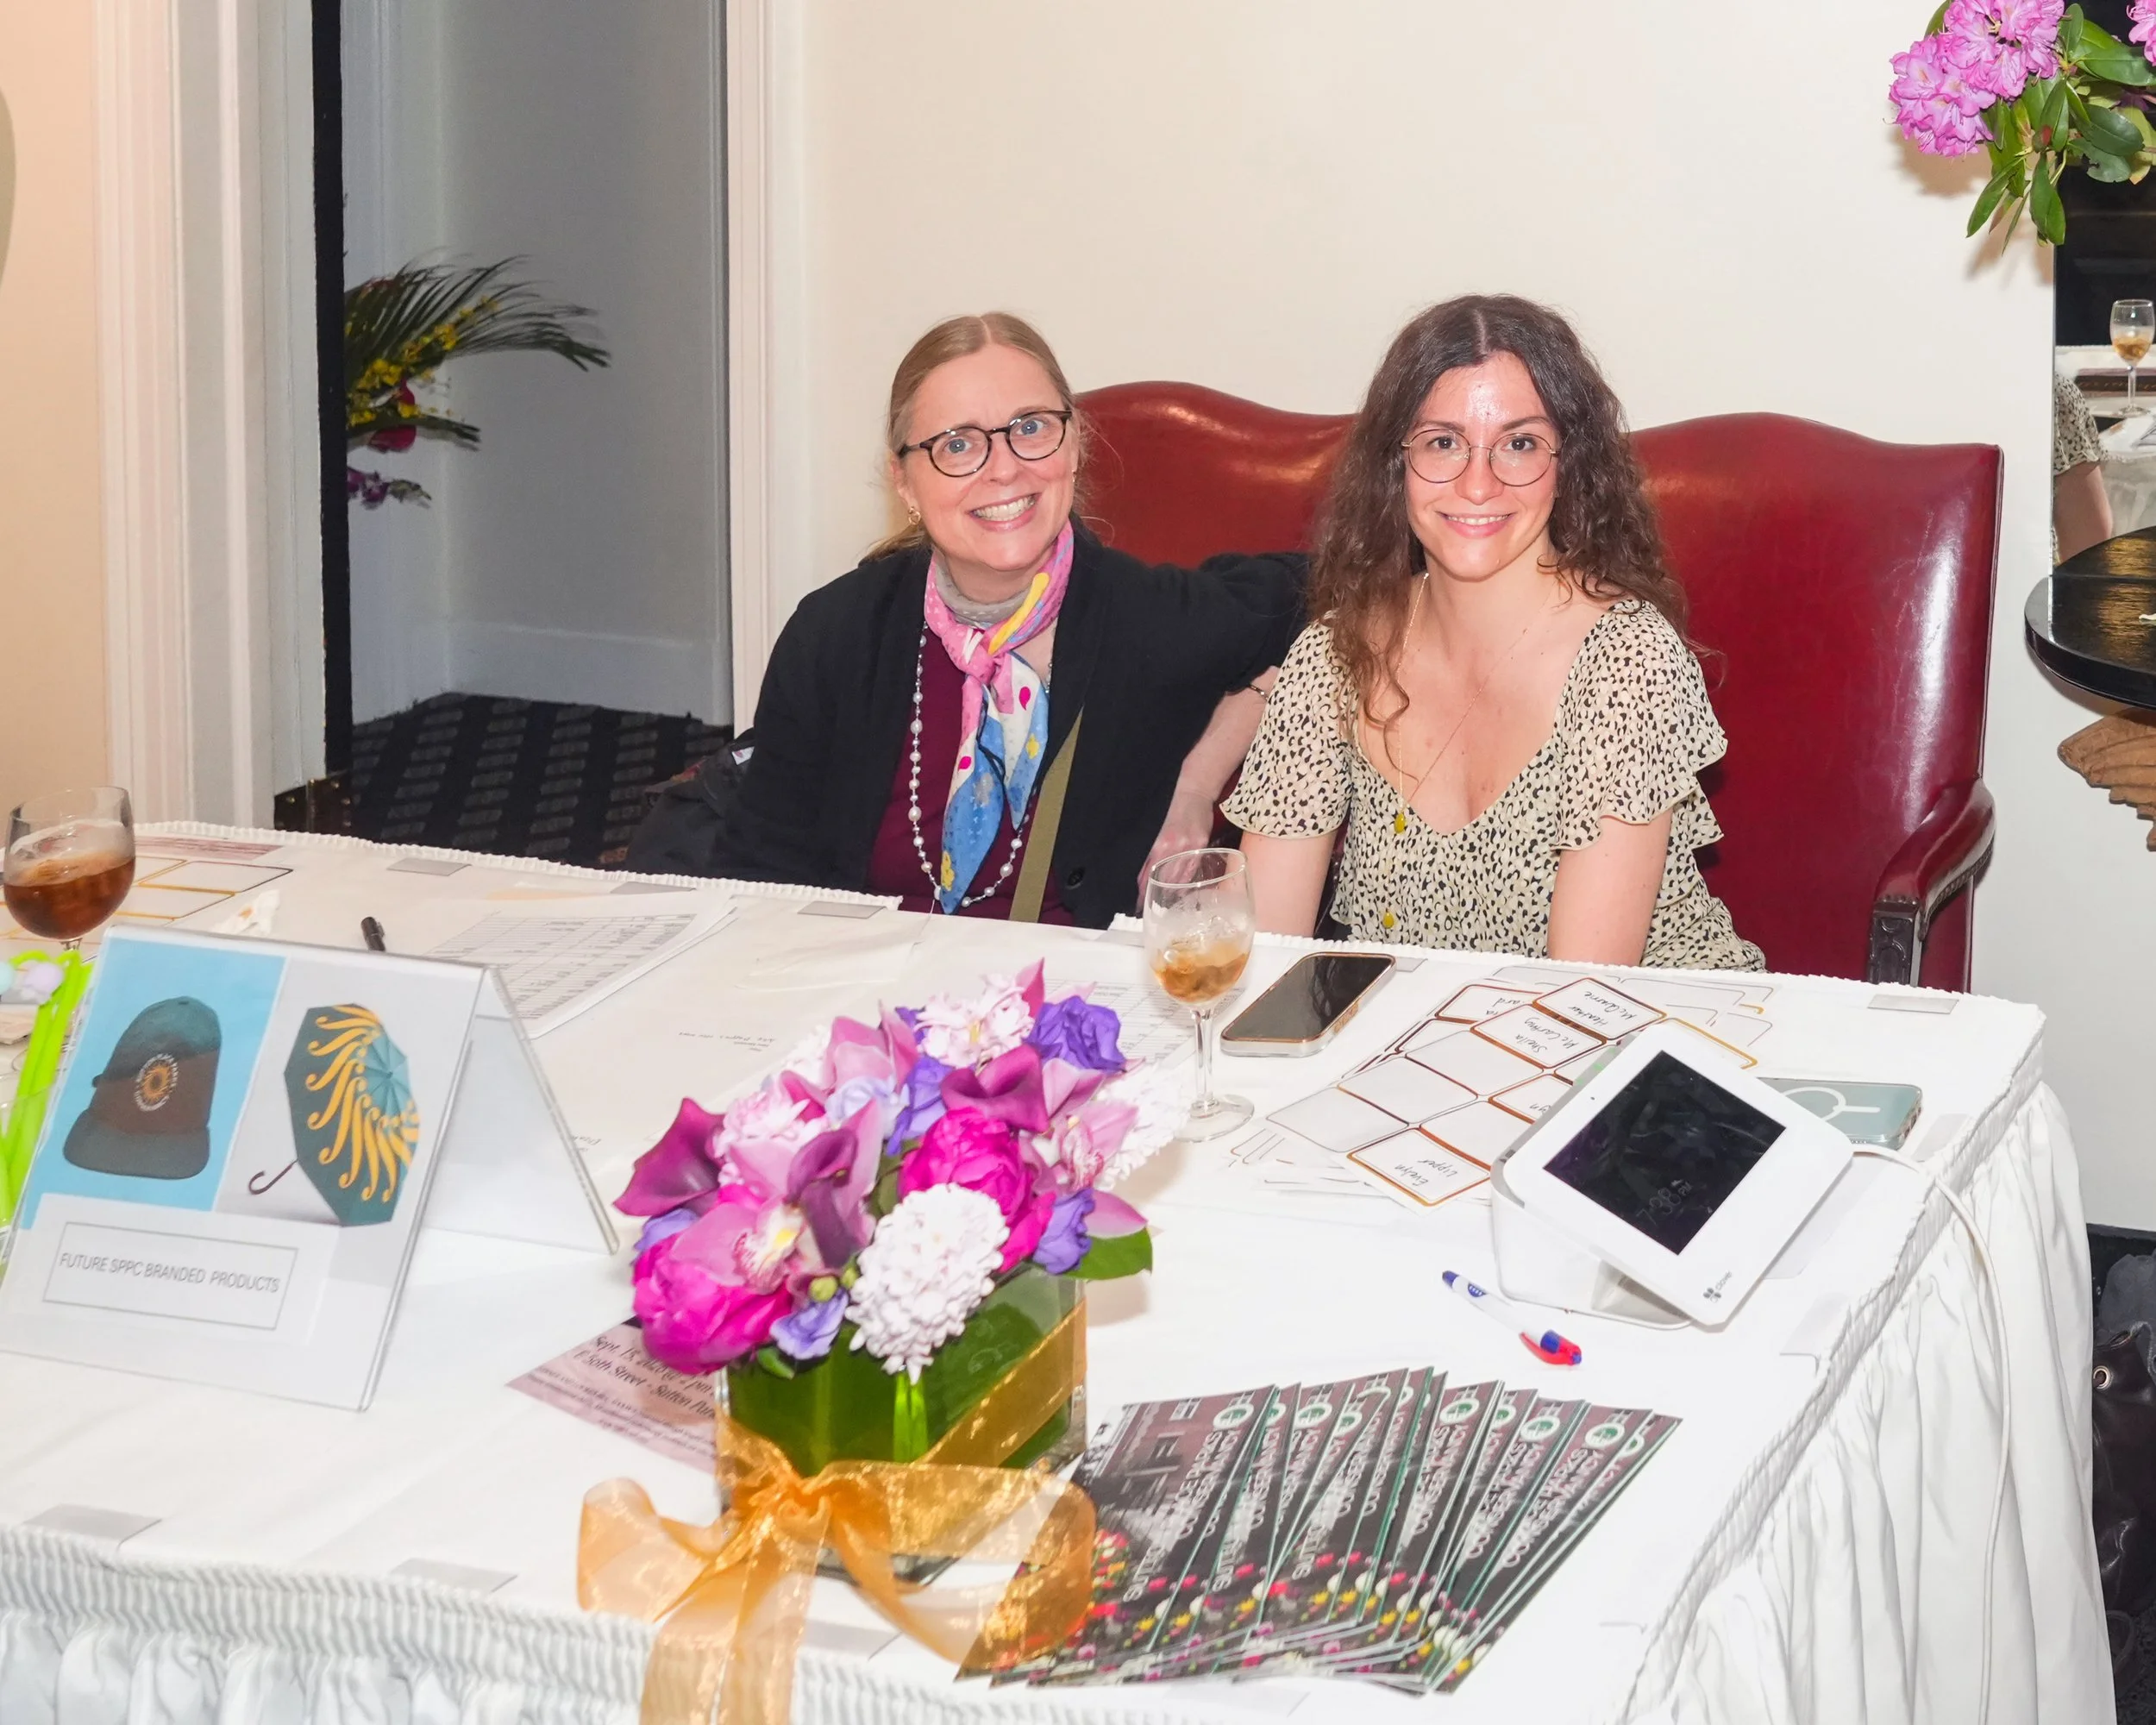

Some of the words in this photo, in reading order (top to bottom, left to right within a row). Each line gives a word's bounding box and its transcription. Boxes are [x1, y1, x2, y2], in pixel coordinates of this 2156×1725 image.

[1568, 1005, 1608, 1029] Heather
[1515, 1033, 1548, 1053] Sheila
[1395, 1163, 1429, 1188] Evelyn
[1417, 1158, 1458, 1178] Lipper
[59, 1252, 109, 1272] FUTURE
[110, 1258, 143, 1277] SPPC
[144, 1262, 206, 1284] BRANDED
[210, 1270, 281, 1294] PRODUCTS
[608, 1364, 649, 1386] Street
